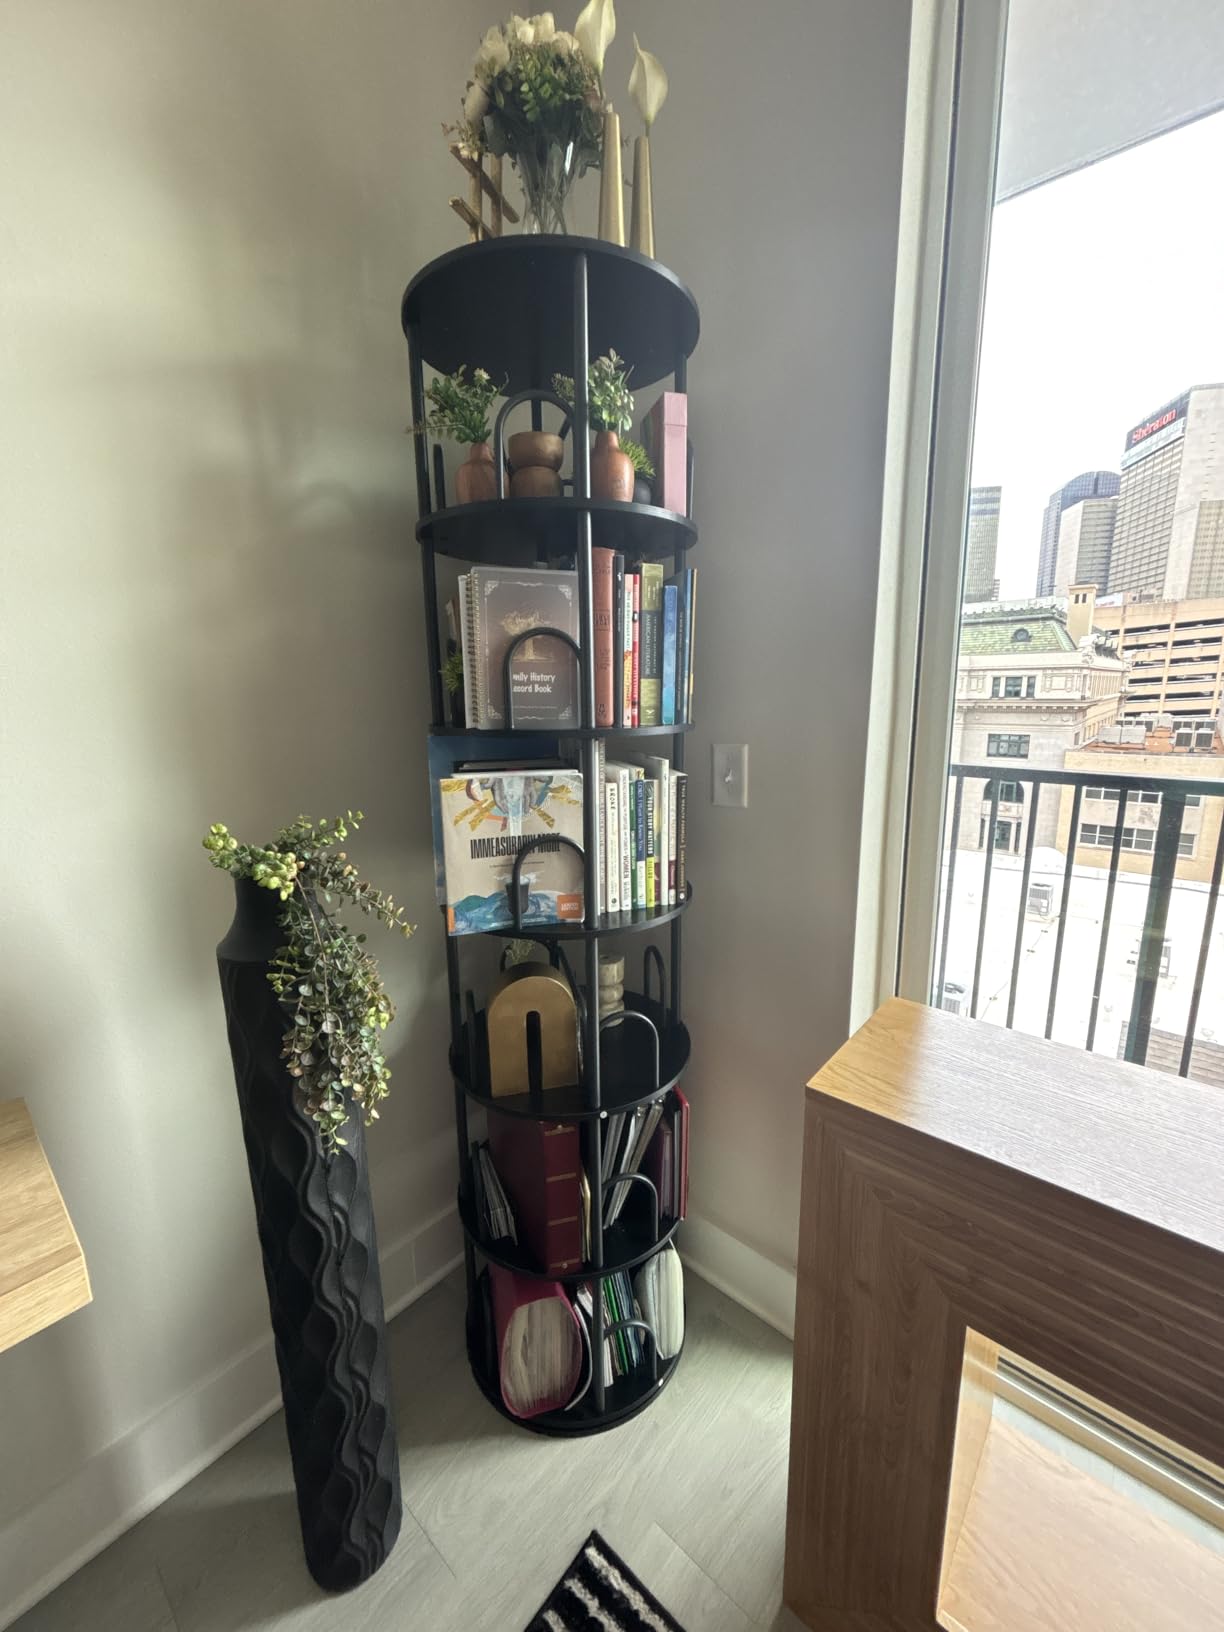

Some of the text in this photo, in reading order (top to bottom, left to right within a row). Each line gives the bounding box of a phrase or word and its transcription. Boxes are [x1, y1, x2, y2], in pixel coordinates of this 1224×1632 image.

[1132, 409, 1176, 443] Sheraton
[513, 672, 556, 683] mily History
[534, 684, 552, 693] Book
